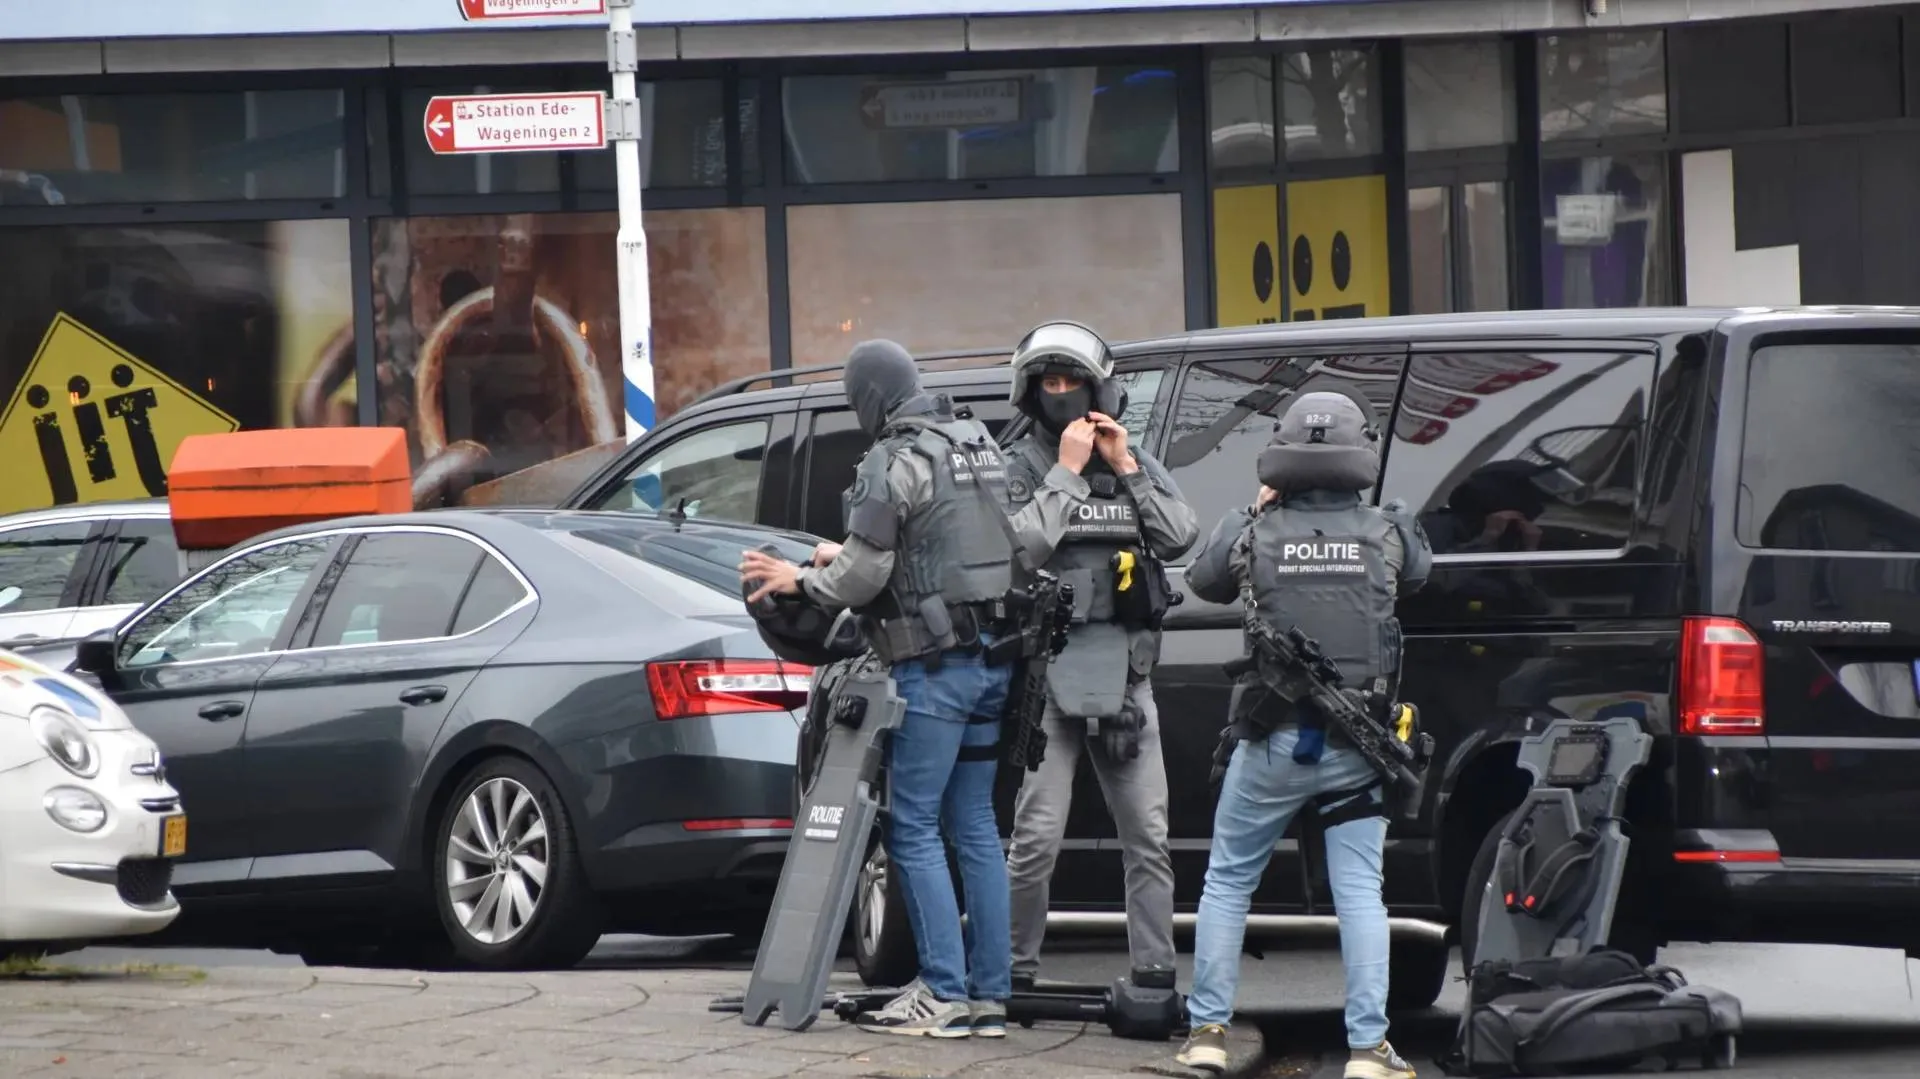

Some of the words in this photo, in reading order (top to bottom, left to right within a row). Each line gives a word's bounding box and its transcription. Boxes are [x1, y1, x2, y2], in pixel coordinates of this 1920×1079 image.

[476, 103, 535, 118] Station
[541, 102, 576, 116] Ede-
[477, 126, 577, 143] Wageningen
[583, 126, 591, 137] 2
[1072, 504, 1133, 520] OLITIE
[1284, 543, 1360, 560] POLITIE
[1772, 620, 1892, 633] TRANSPORTER
[808, 805, 845, 825] POLITIE
